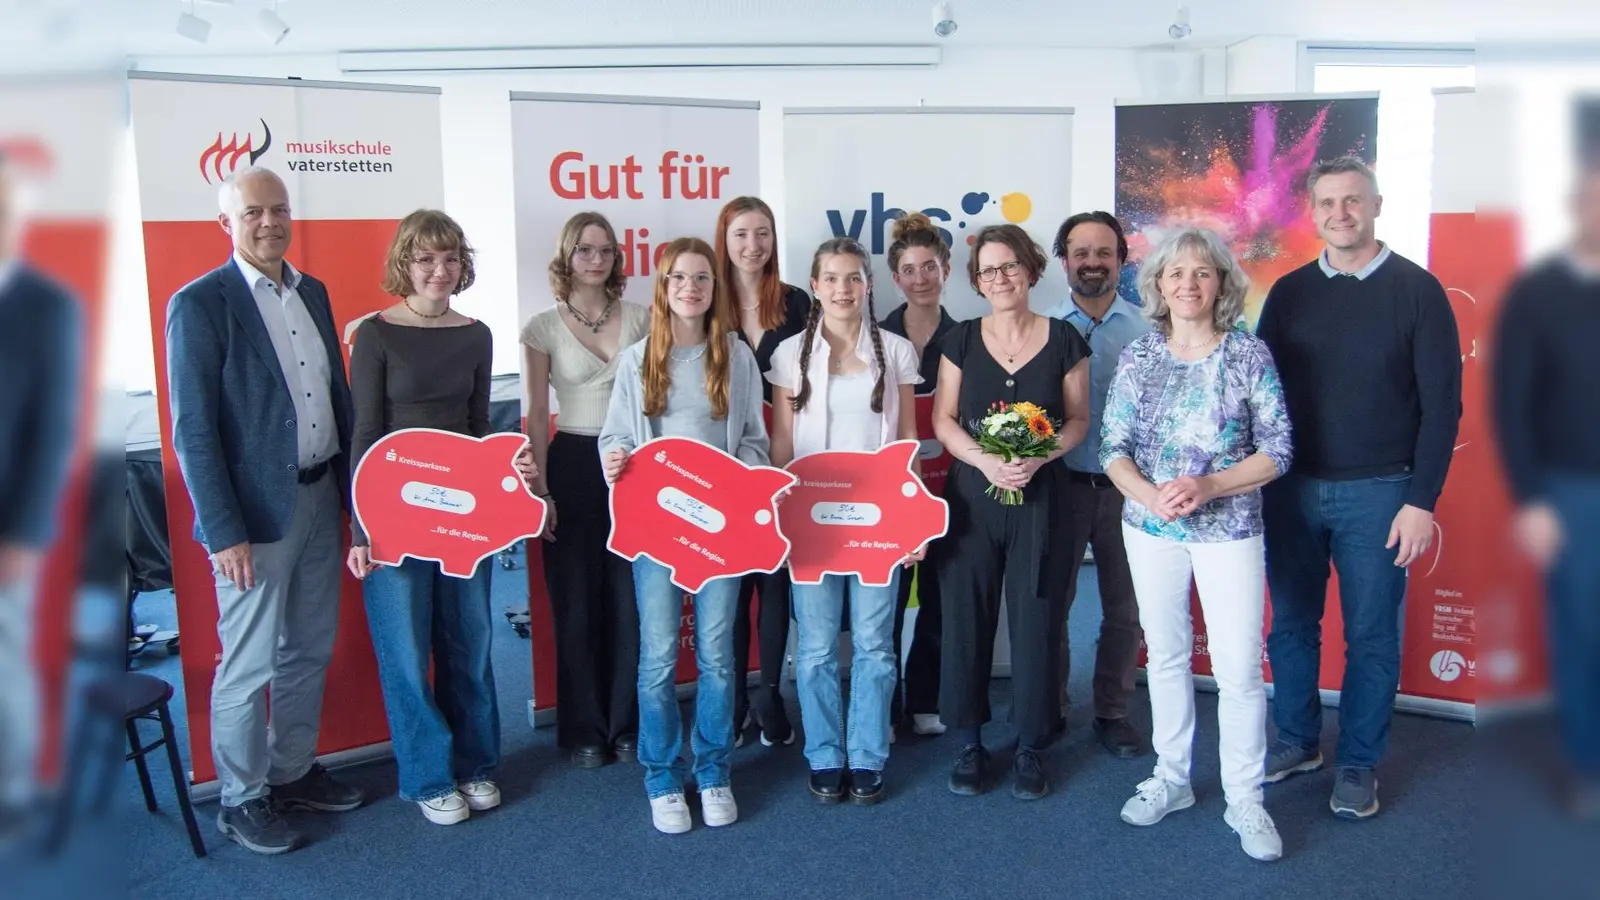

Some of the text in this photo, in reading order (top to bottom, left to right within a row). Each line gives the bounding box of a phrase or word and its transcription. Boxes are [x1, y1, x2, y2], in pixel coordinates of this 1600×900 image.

[286, 140, 392, 156] musikschule
[287, 158, 393, 173] vaterstetten
[549, 150, 730, 200] Gut für
[826, 192, 953, 255] vhs
[398, 456, 451, 473] Kreissparkasse
[665, 459, 713, 490] Kreissparkasse
[803, 479, 852, 490] Kreissparkasse
[449, 527, 461, 538] die
[461, 530, 490, 543] Region.
[688, 540, 702, 553] die
[701, 547, 726, 567] Region.
[860, 541, 873, 549] die
[873, 541, 900, 550] Region.
